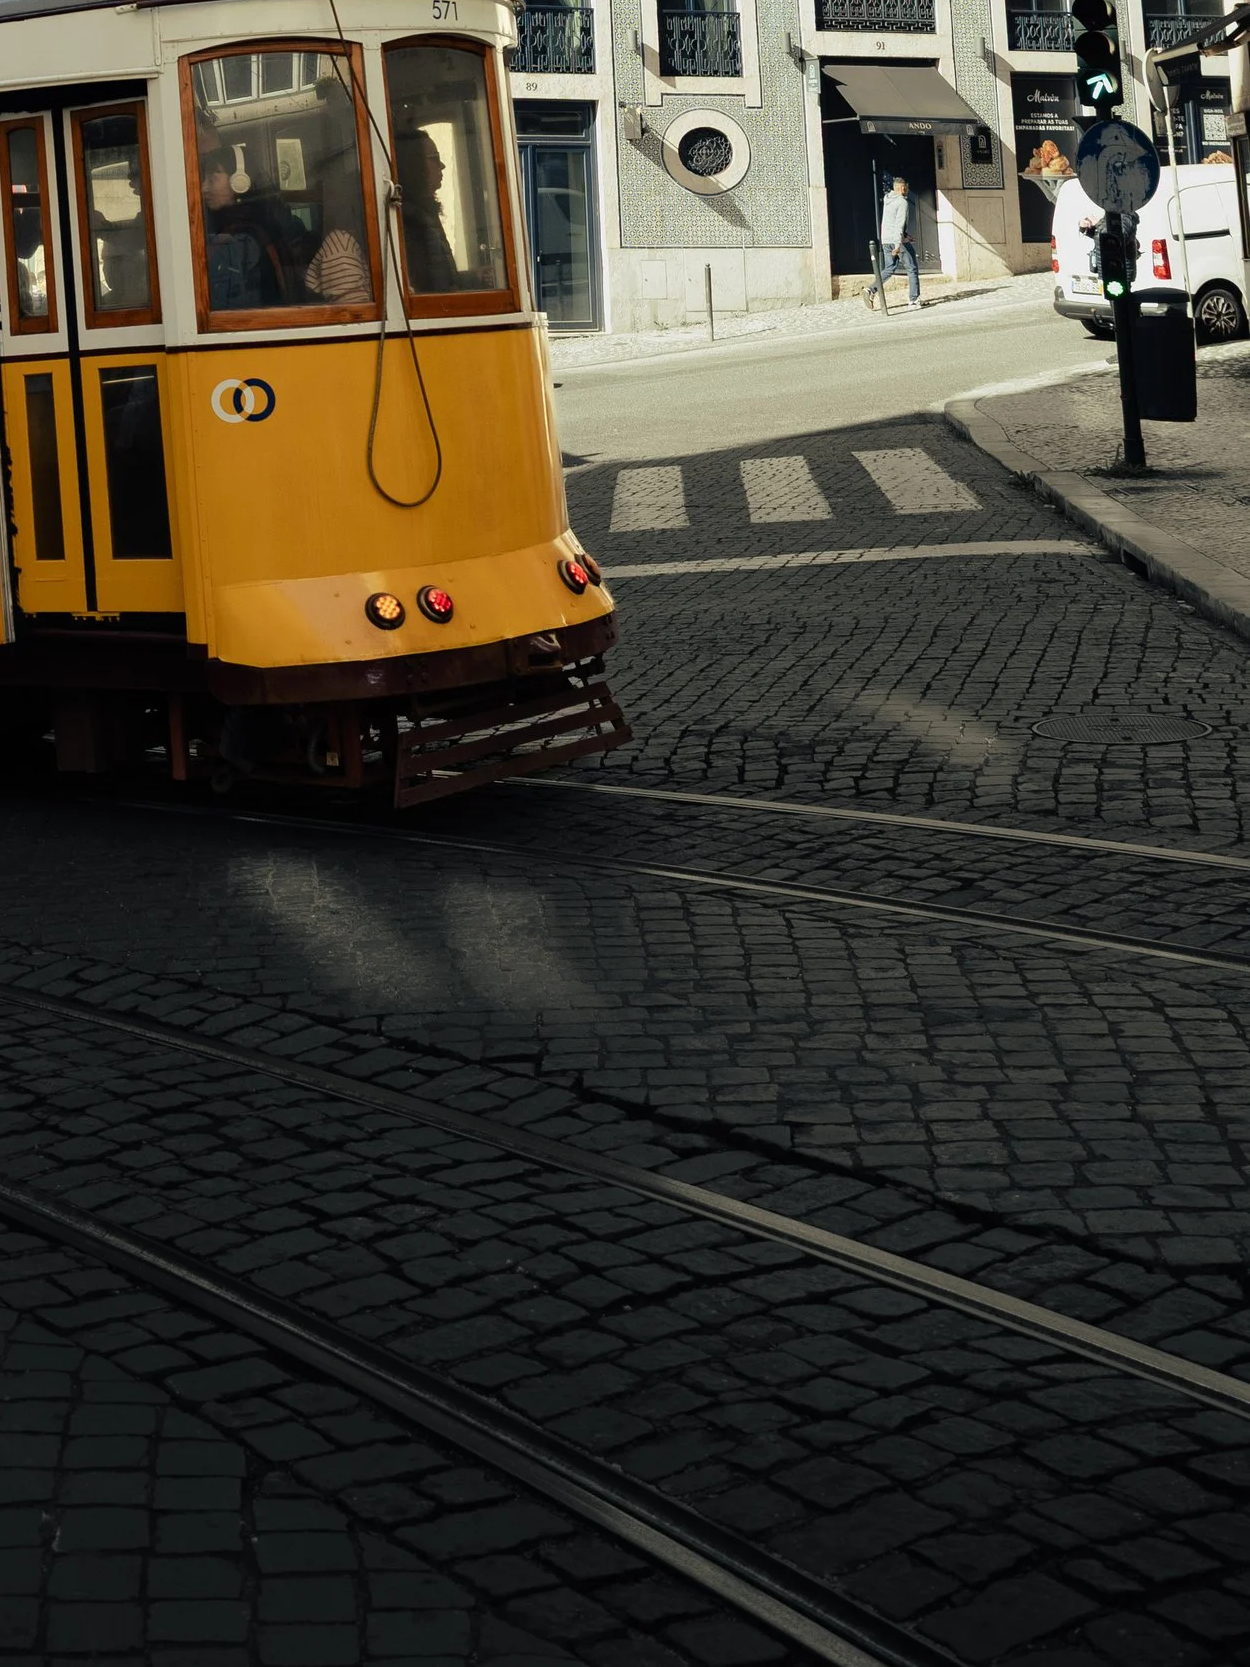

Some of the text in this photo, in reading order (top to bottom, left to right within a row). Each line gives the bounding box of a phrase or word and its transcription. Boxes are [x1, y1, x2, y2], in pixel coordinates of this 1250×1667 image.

[432, 0, 459, 22] 571
[876, 42, 886, 51] 91
[526, 82, 538, 92] 89
[909, 122, 932, 130] ANDO
